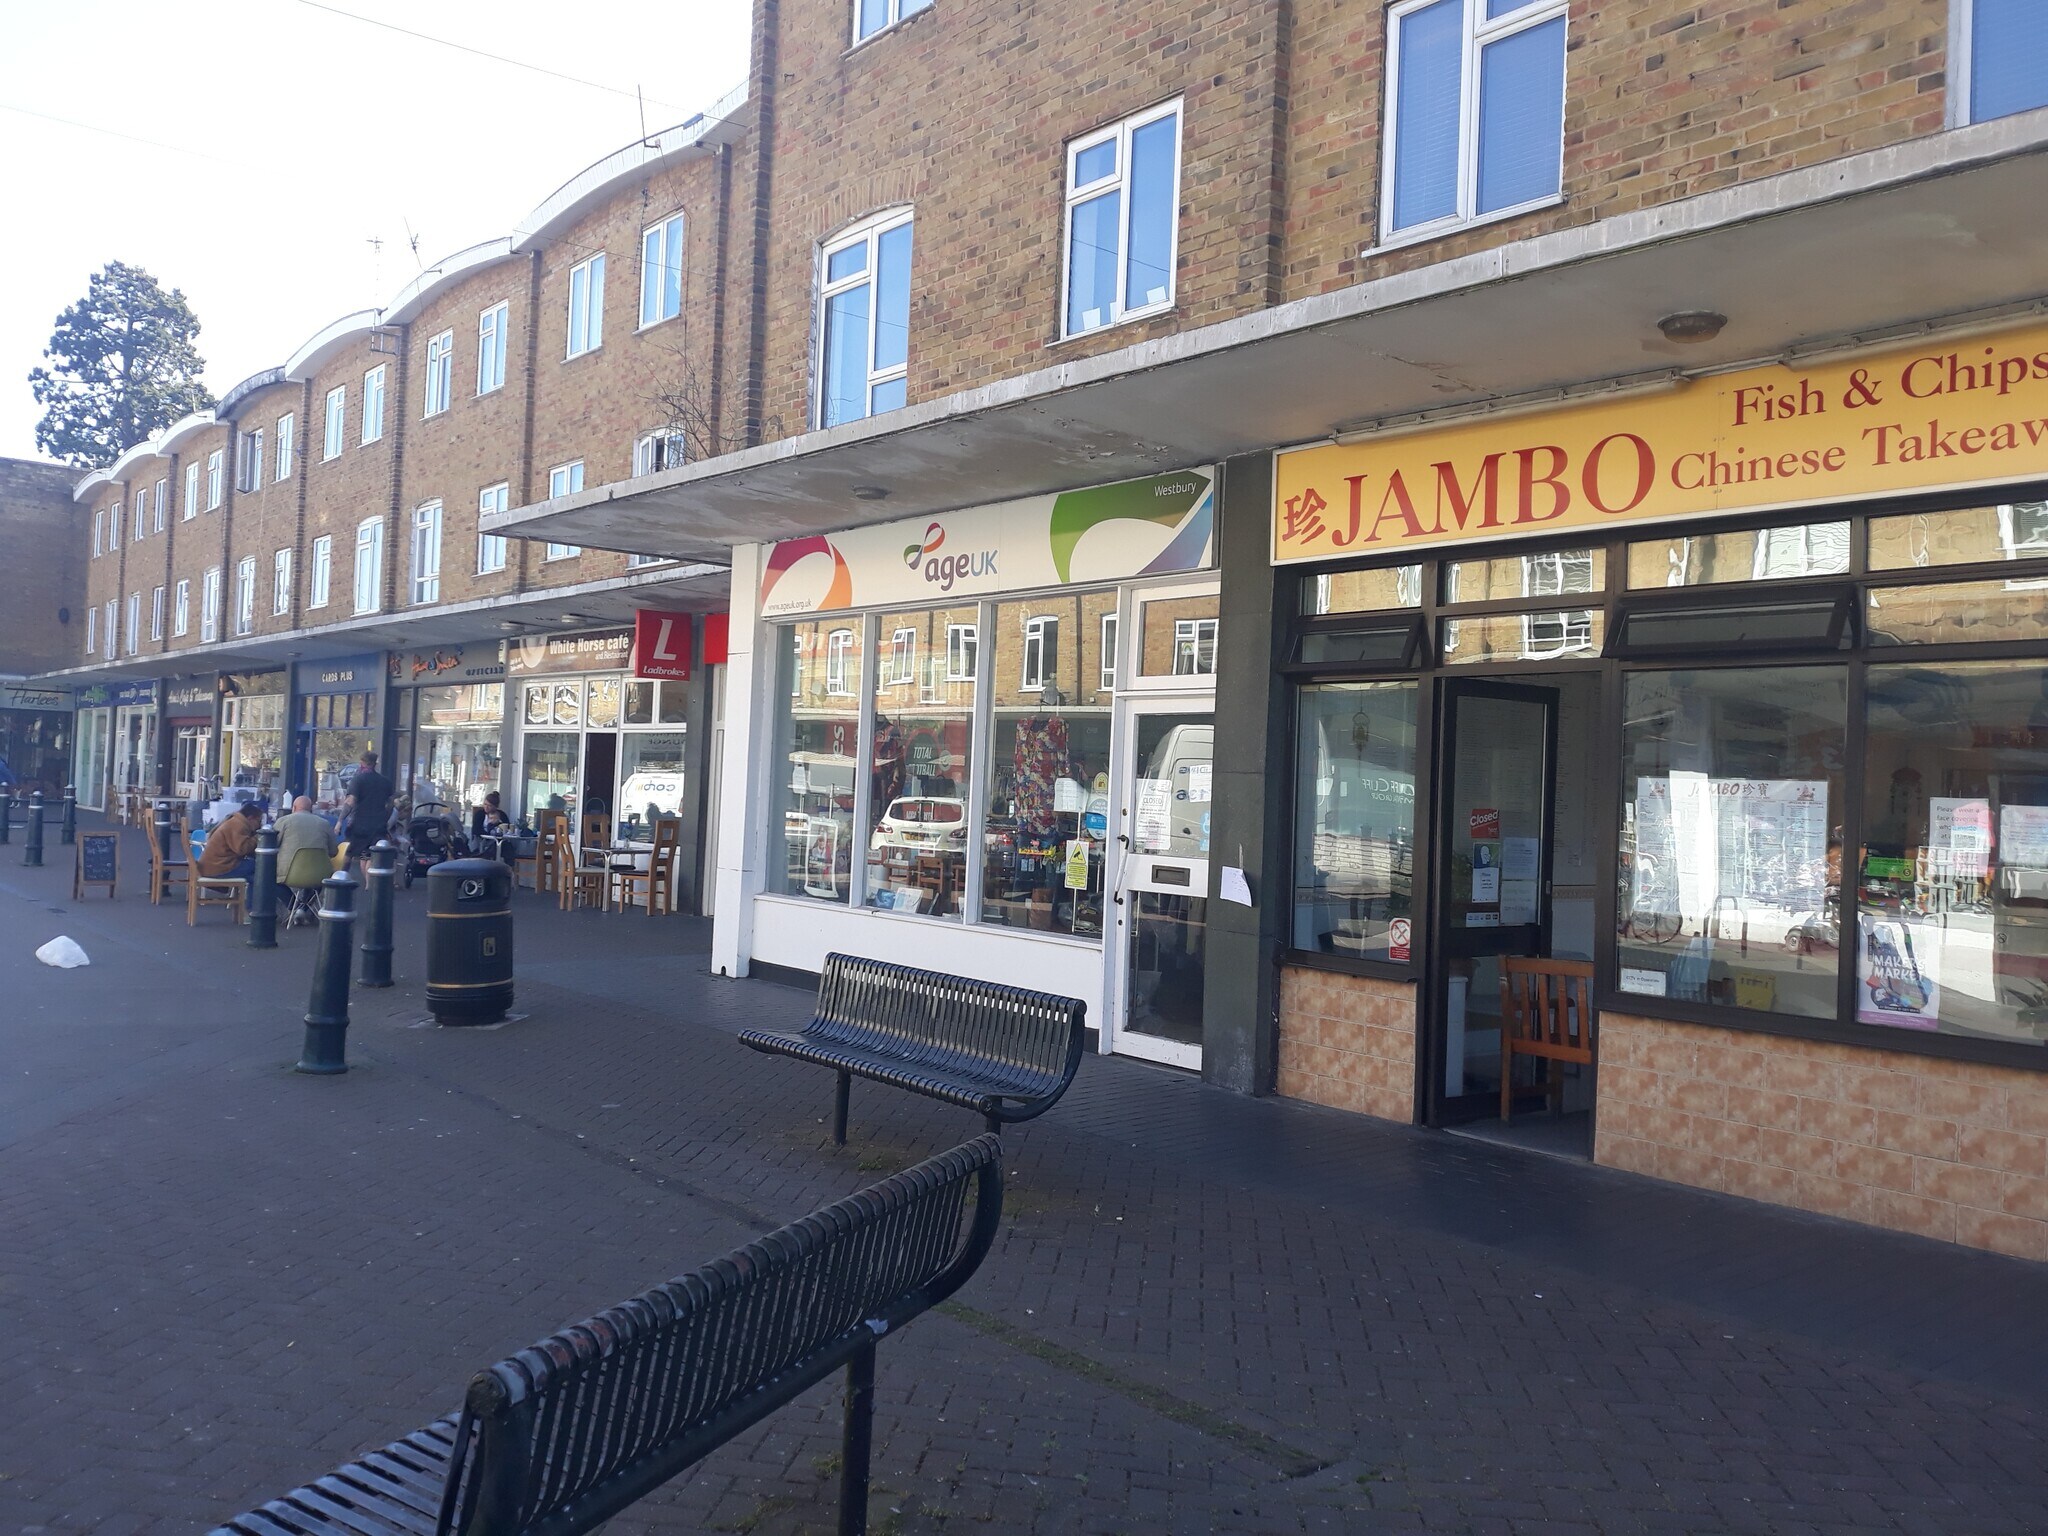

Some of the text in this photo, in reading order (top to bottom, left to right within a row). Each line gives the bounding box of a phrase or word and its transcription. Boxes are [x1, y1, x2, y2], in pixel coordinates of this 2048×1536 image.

[1731, 346, 2048, 427] Fish & Chips
[1671, 446, 1846, 491] Chinese
[1154, 482, 1197, 497] Westbury
[1331, 433, 1656, 547] JAMBO
[1282, 488, 1327, 545] 珍
[767, 598, 812, 611] www.ageuk.org.uk
[550, 632, 629, 655] White Horse café
[321, 670, 353, 683] CARDS PLUS
[643, 665, 686, 676] Ladbrokes
[913, 746, 932, 759] TOTAL
[1470, 809, 1498, 827] Closed
[1936, 814, 1951, 822] face
[1874, 955, 1925, 972] MAKERS
